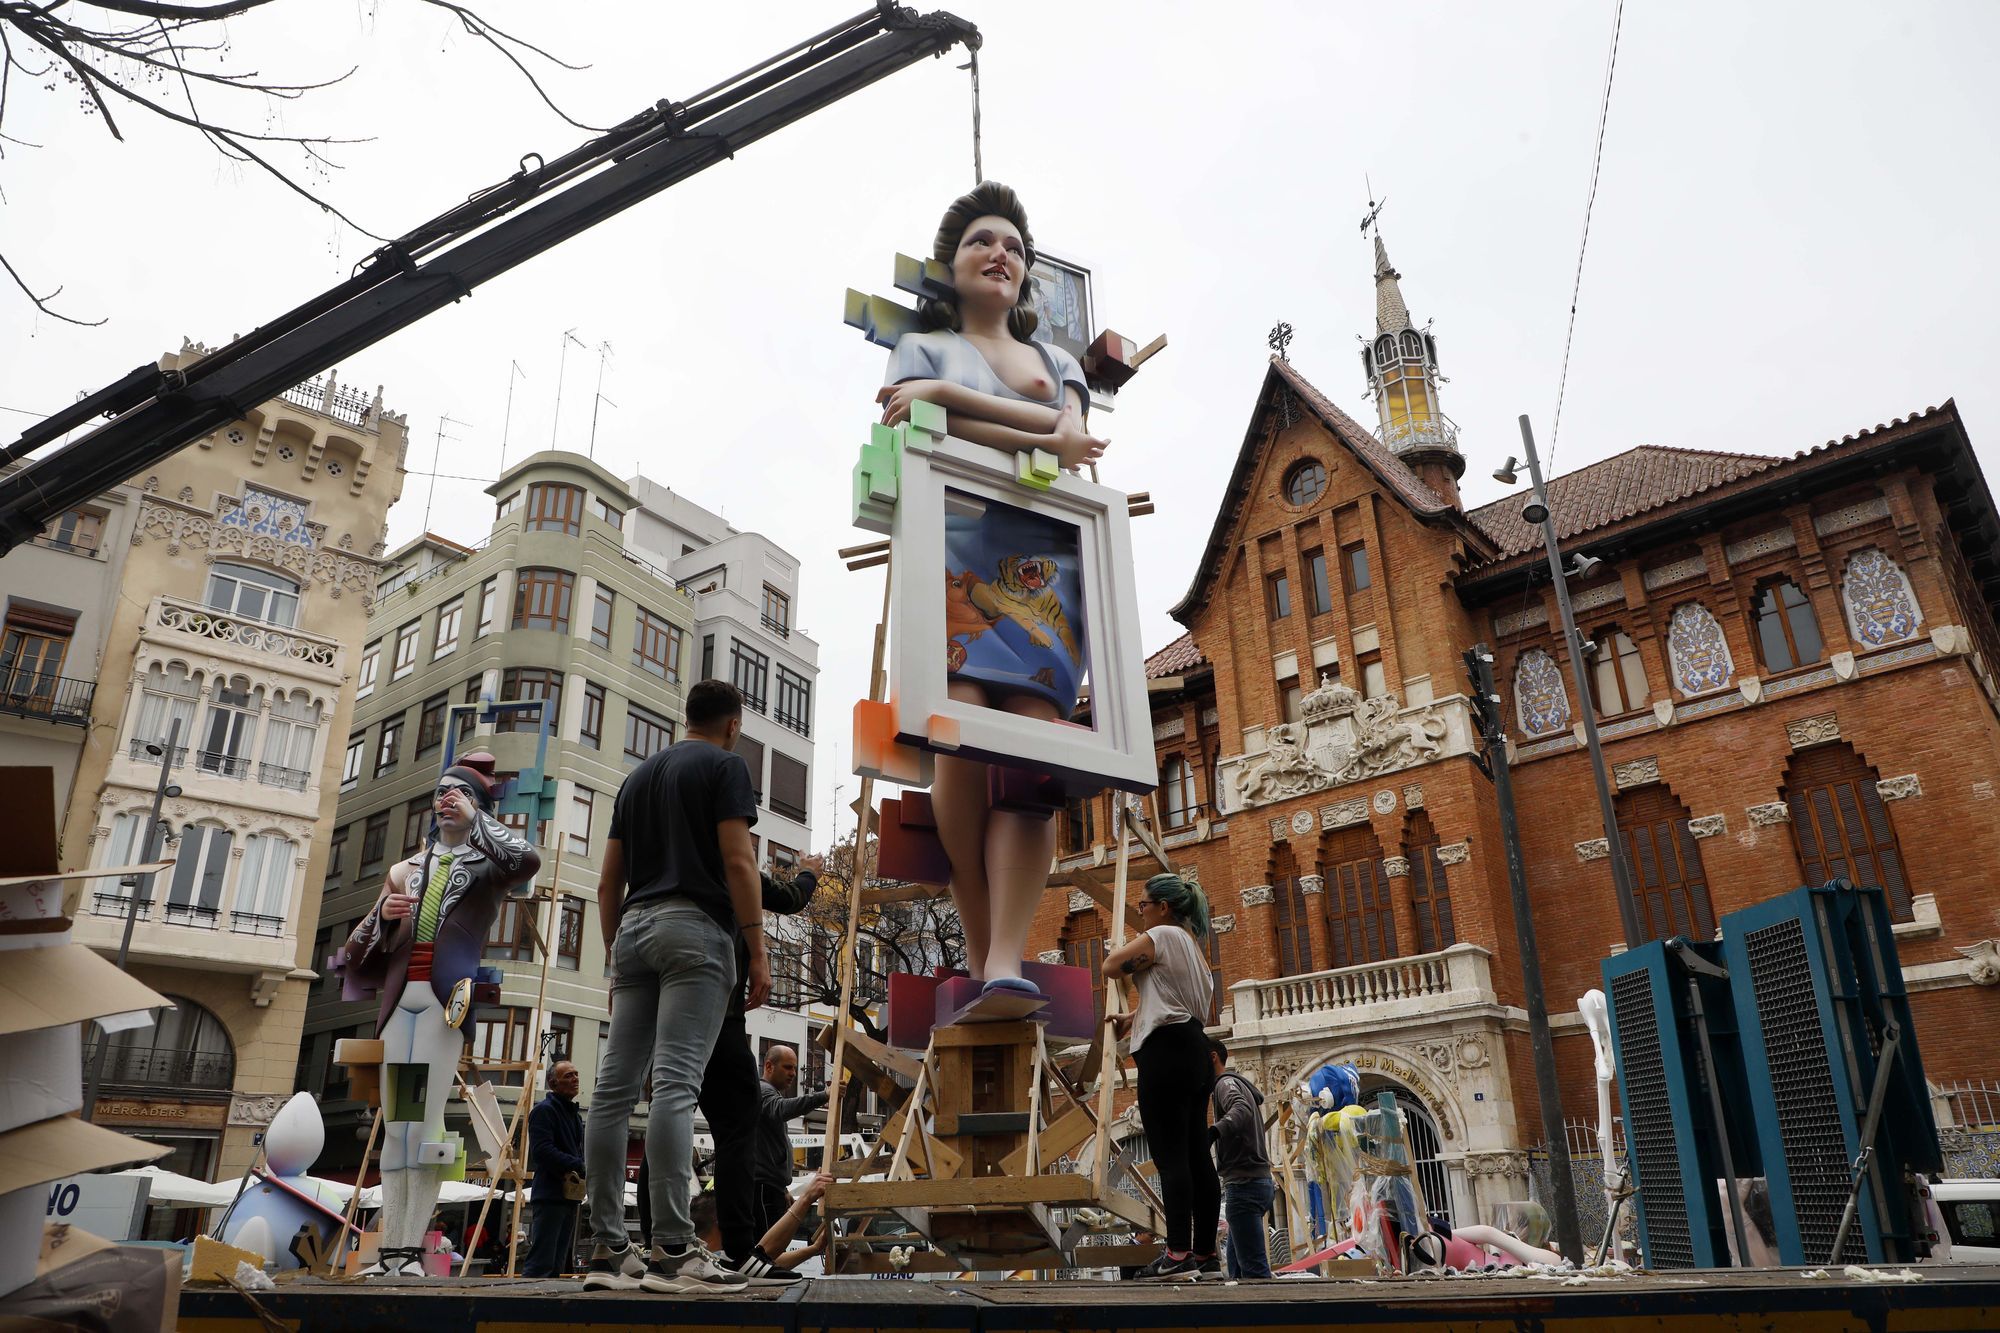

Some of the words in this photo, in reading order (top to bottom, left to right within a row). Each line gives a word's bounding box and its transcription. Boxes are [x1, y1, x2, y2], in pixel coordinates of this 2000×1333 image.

[99, 1105, 186, 1118] MERCADERS
[1355, 1054, 1377, 1068] del
[1380, 1057, 1454, 1141] Mediterráneo
